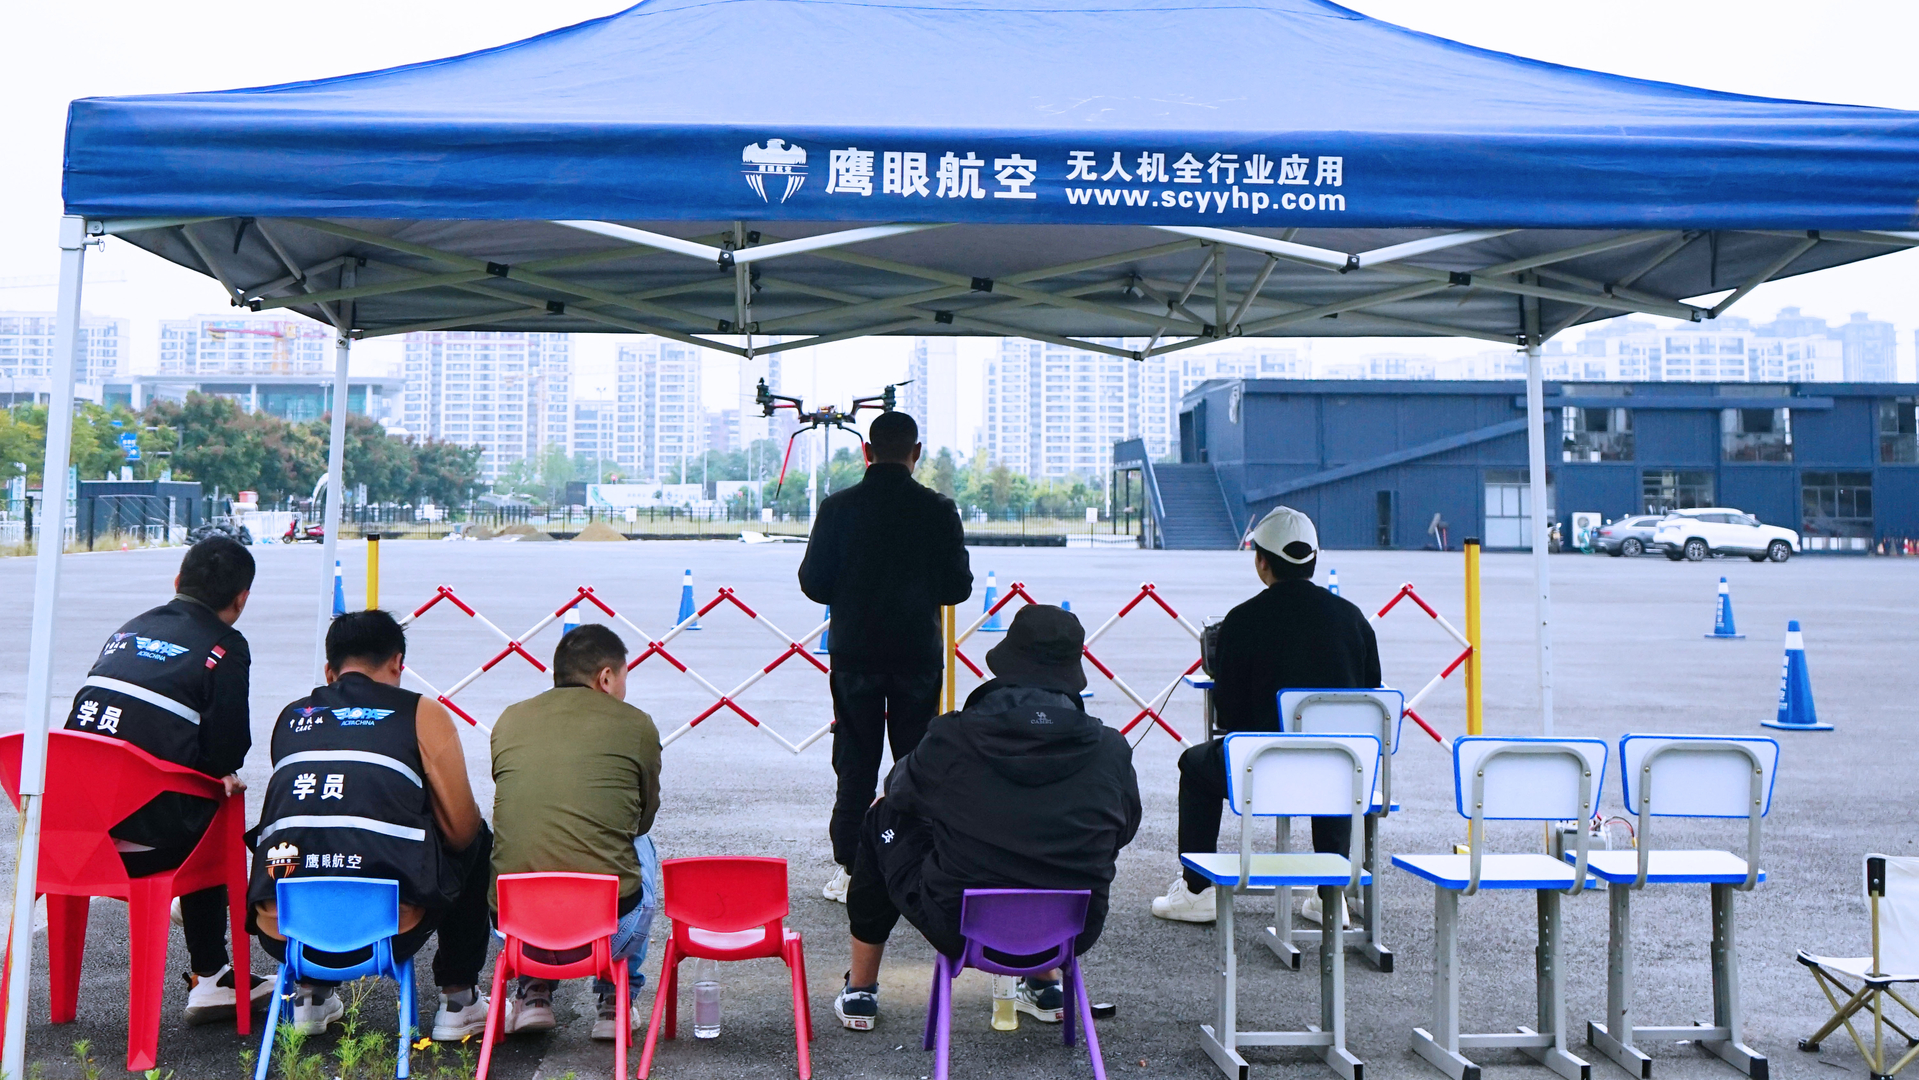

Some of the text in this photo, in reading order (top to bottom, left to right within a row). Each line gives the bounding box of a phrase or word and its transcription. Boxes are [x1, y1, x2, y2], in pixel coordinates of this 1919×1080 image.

[825, 147, 1038, 200] 鹰眼航空
[1065, 150, 1344, 188] 无人机全行业应用
[1065, 186, 1346, 214] www.scyyhp.com
[77, 700, 122, 734] 学员
[292, 773, 345, 800] 学员
[305, 853, 362, 869] 鹰眼航空
